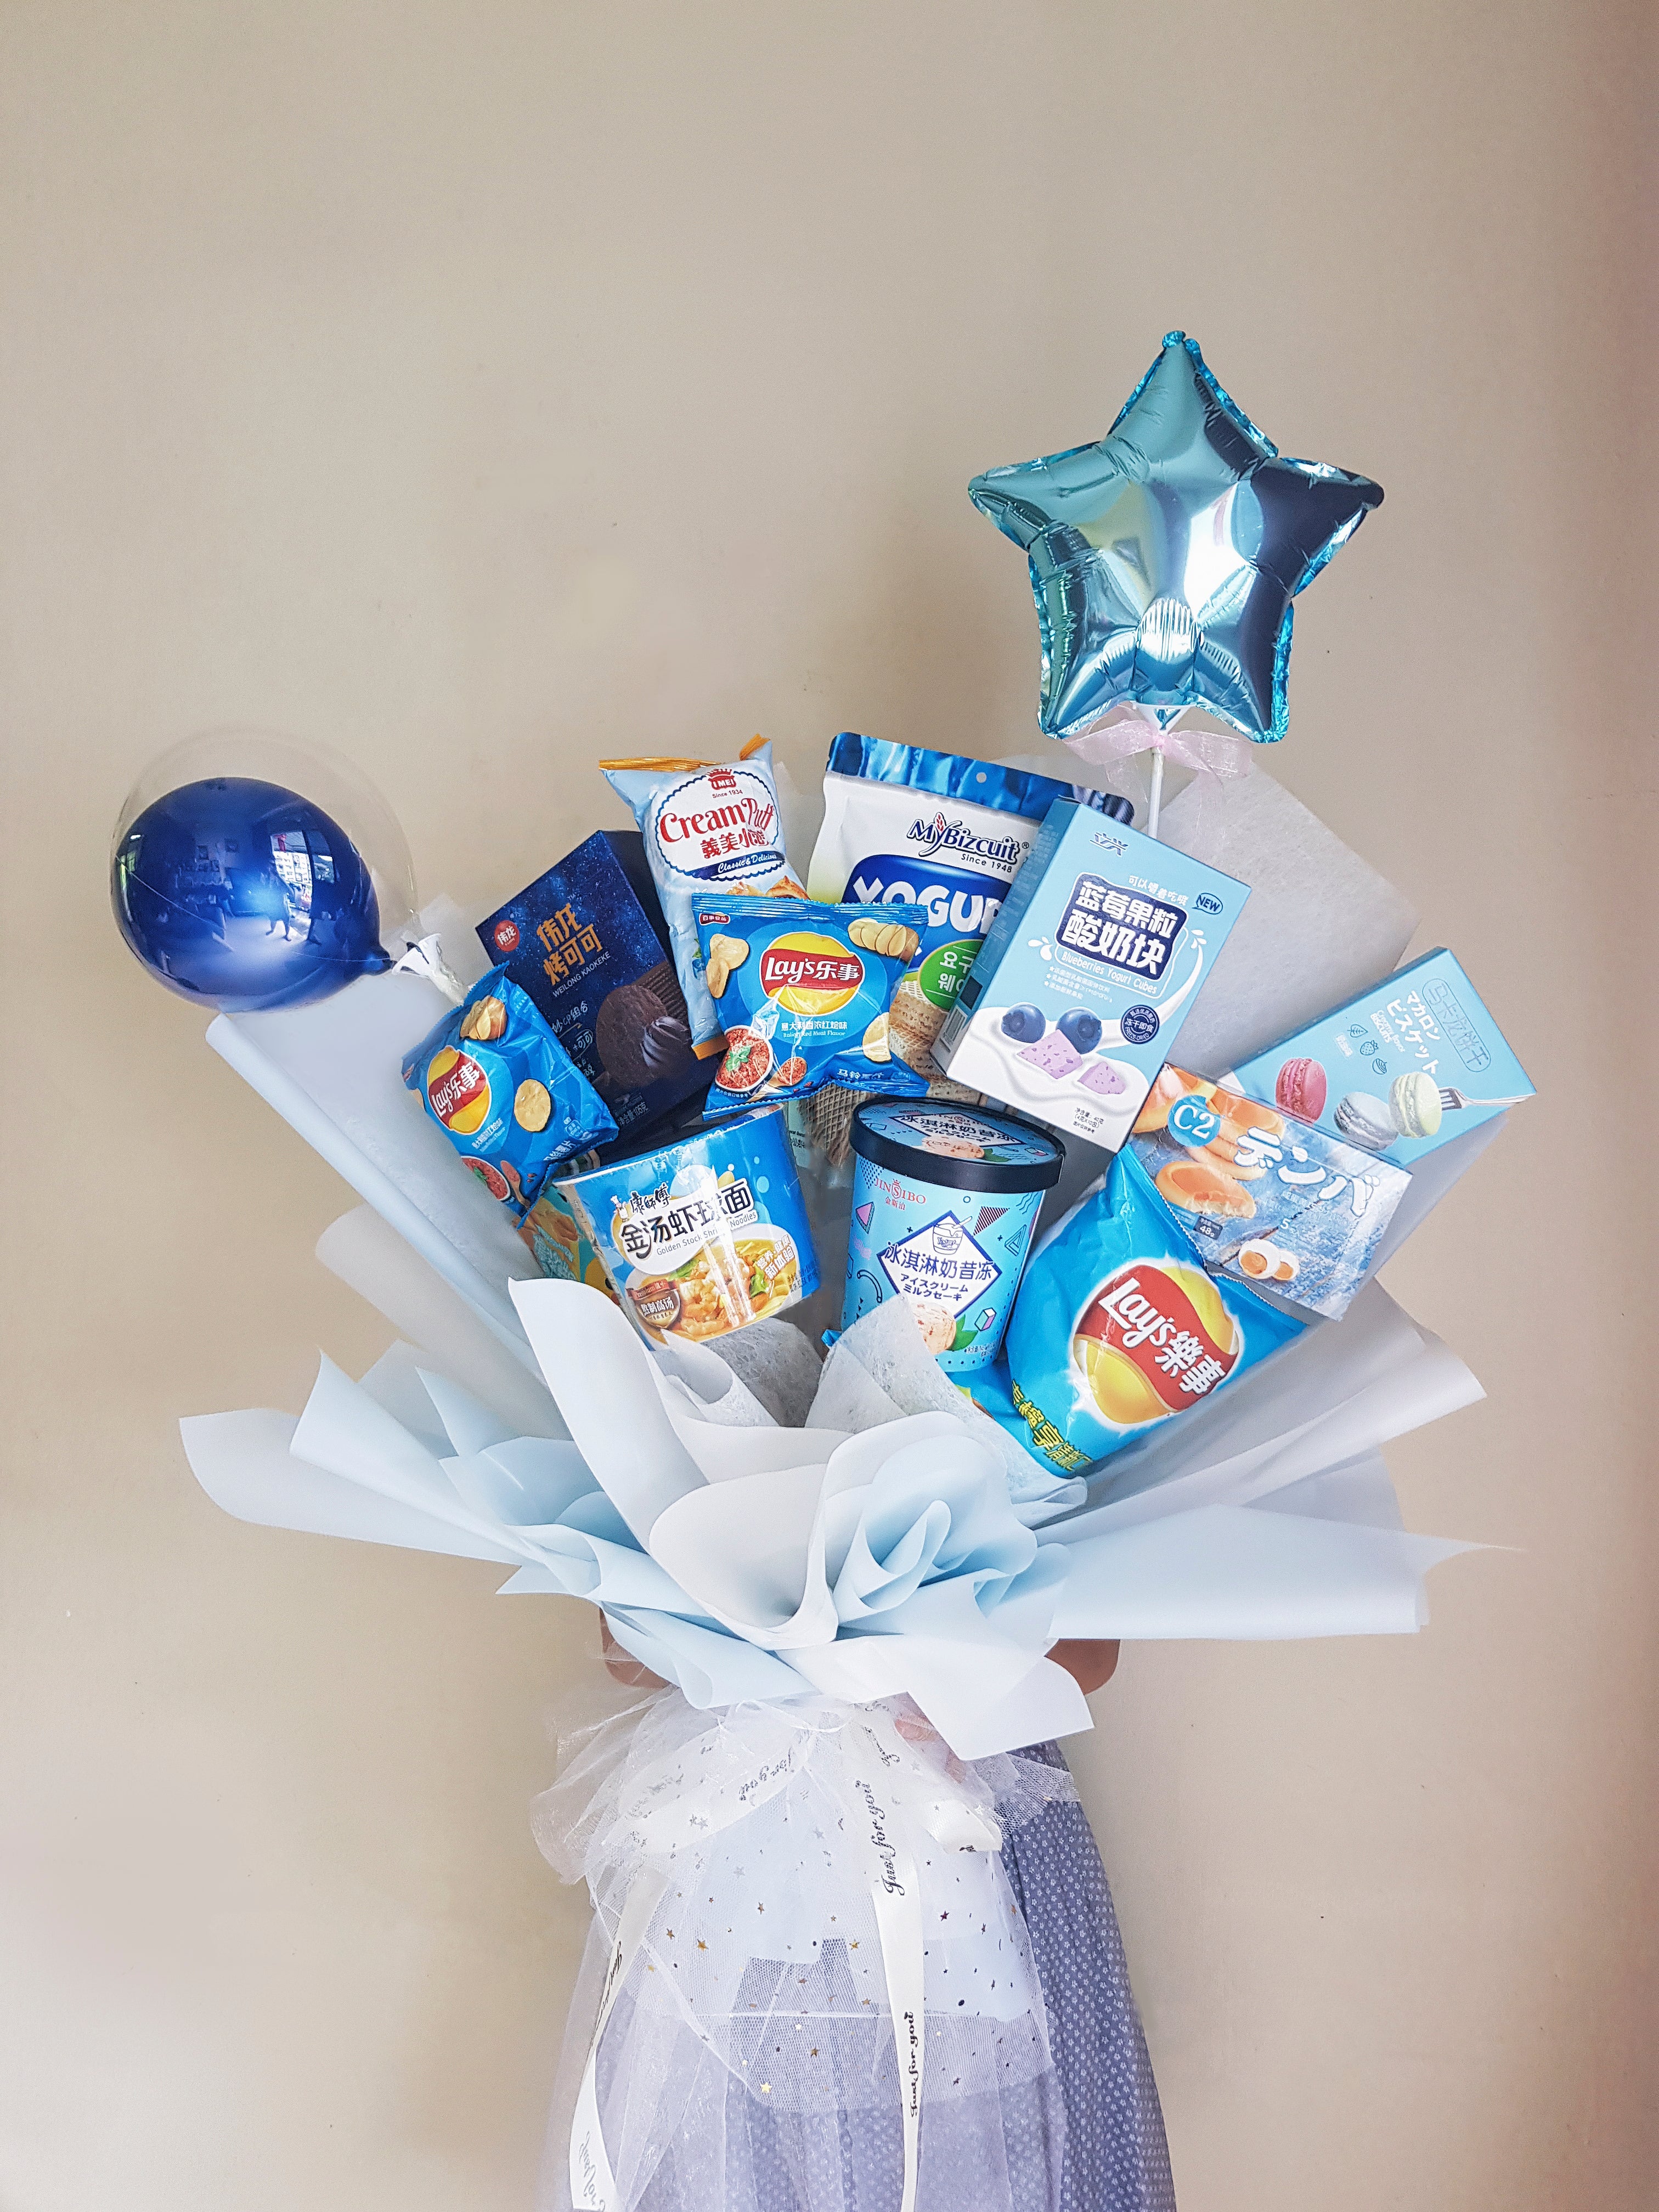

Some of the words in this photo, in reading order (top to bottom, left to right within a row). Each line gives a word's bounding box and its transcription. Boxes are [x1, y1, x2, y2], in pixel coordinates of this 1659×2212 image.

[660, 804, 746, 843] Cream
[741, 798, 775, 831] Puff
[718, 861, 745, 873] Classic
[961, 854, 987, 866] Since
[991, 861, 1013, 873] 1948
[1075, 881, 1178, 939] 蓝莓果粒
[1196, 894, 1221, 912] NEW
[543, 923, 602, 986] 烤可可
[1062, 909, 1166, 975] 酸奶块
[552, 973, 582, 997] WEILONG
[582, 951, 611, 978] KAOKEKE
[765, 956, 816, 984] Lay's
[814, 961, 861, 981] 乐事
[1062, 951, 1105, 975] Blueberries
[1107, 967, 1132, 985] Yogurt
[1133, 977, 1158, 995] Cubes
[1407, 990, 1441, 1040] マカロン
[1428, 984, 1489, 1065] 马卡龙饼干
[1386, 998, 1439, 1075] ビスケット
[1174, 1104, 1216, 1139] C2
[656, 1243, 681, 1256] Golden
[682, 1234, 703, 1246] Stock
[730, 1210, 757, 1228] Noodles
[884, 1242, 994, 1280] 冰淇淋奶昔冻
[900, 1273, 968, 1292] アイスクリーム
[903, 1283, 962, 1301] ミルクセーキ
[1098, 1277, 1177, 1348] Lay's
[1154, 1330, 1226, 1395] 樂事
[855, 1780, 885, 1820] you
[870, 1818, 896, 1857] for
[879, 1851, 905, 1896] Just
[904, 2011, 919, 2048] you
[908, 2048, 919, 2081] for
